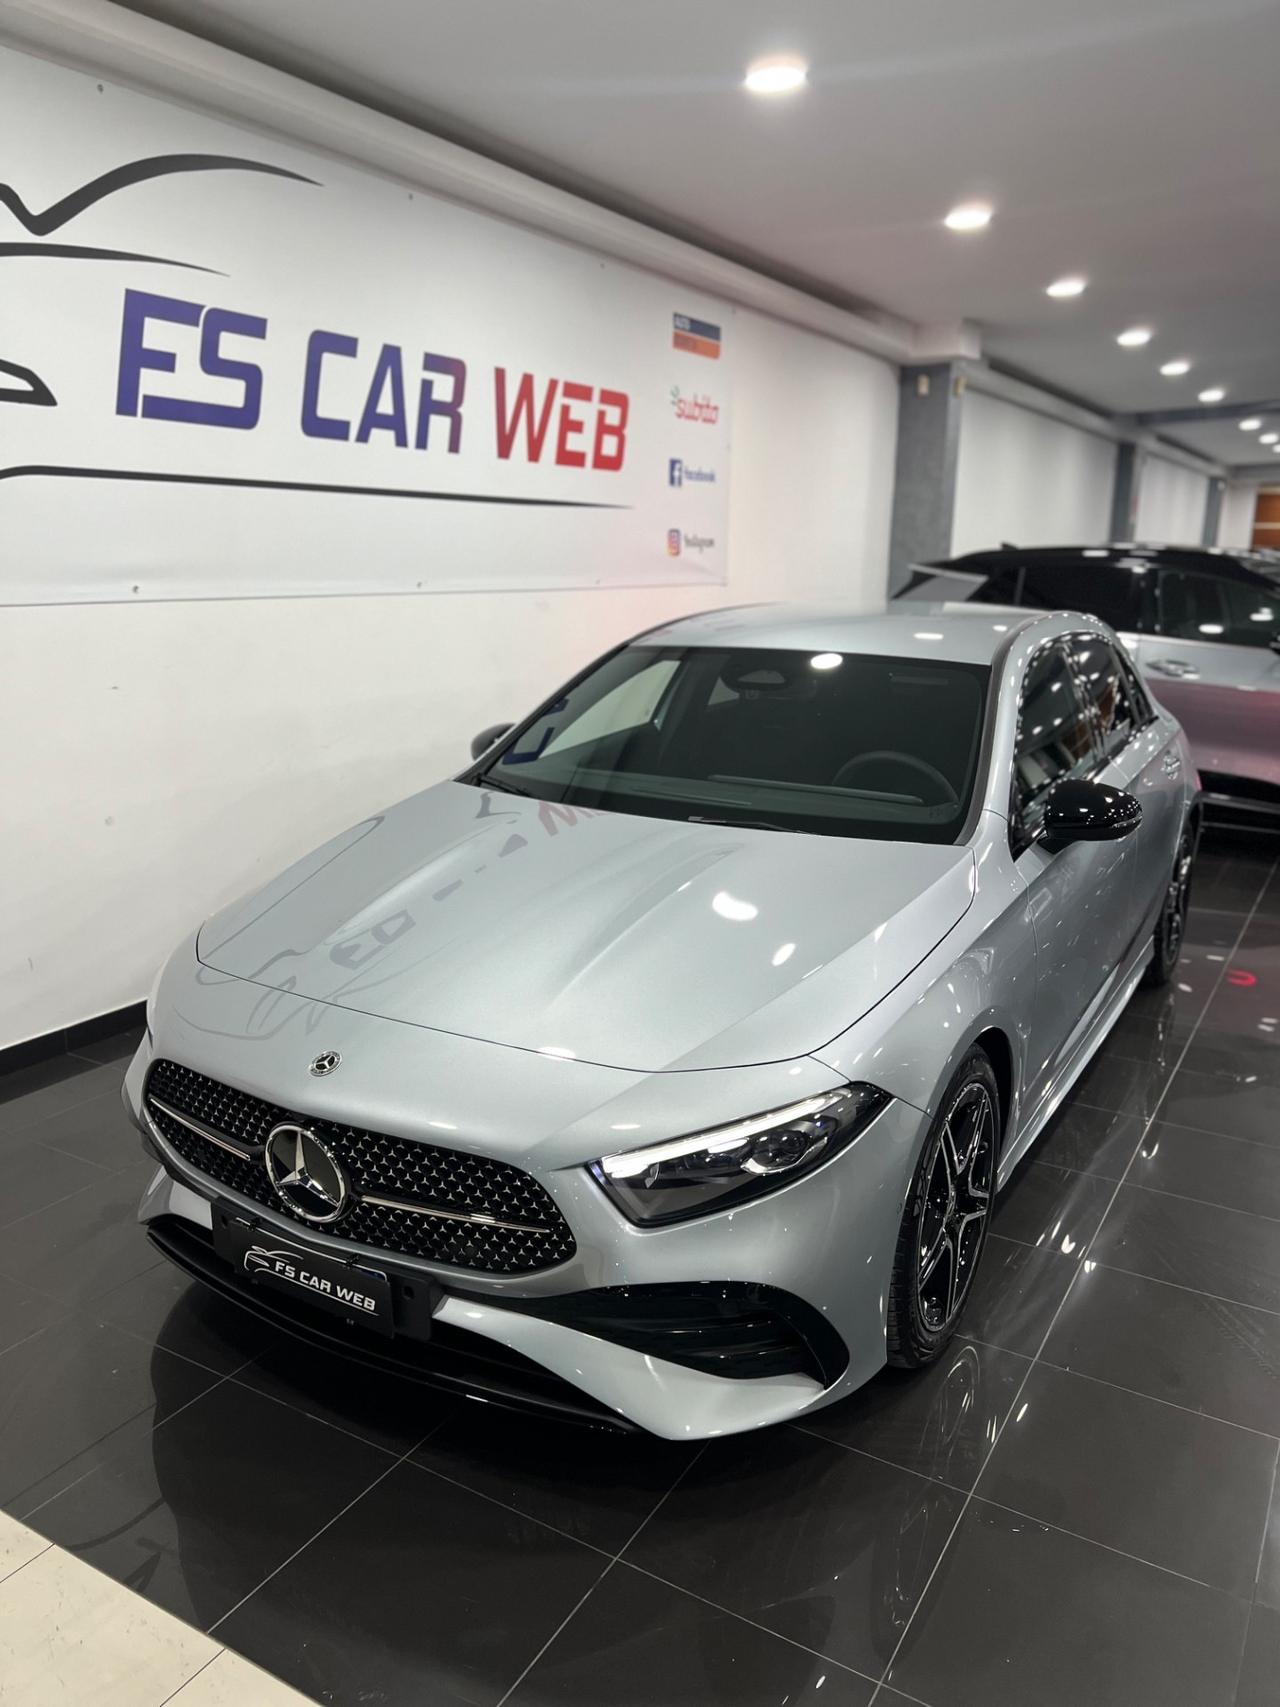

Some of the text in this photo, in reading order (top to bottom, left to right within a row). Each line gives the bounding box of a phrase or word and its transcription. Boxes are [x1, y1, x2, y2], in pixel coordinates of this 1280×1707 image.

[116, 288, 631, 473] FS CAR WEB
[275, 1261, 376, 1311] FS CAR WEB
